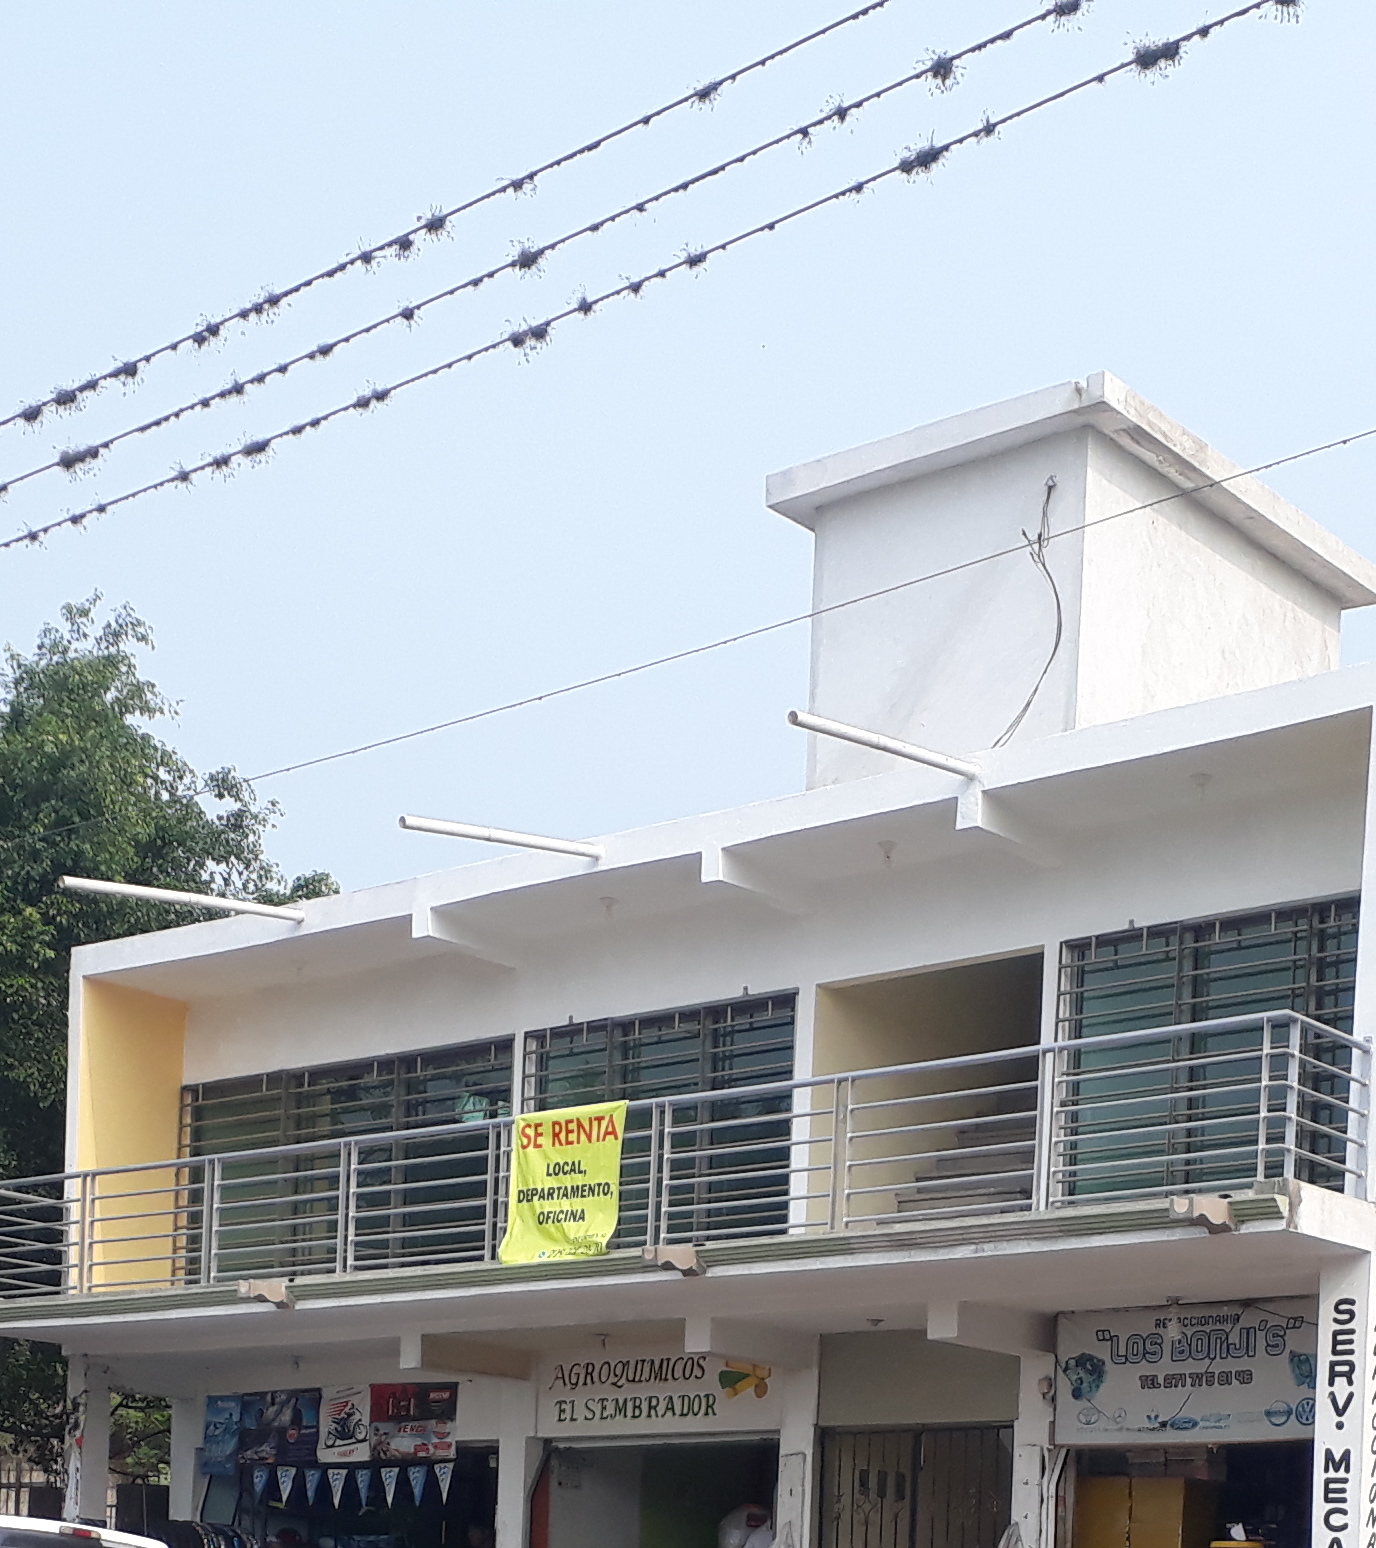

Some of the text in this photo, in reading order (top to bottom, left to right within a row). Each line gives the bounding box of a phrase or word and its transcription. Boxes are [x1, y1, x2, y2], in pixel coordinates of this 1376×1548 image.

[520, 1113, 619, 1150] SE RENTA
[545, 1160, 587, 1177] LOCAL,
[517, 1181, 613, 1204] DEPARTAMENTO,
[537, 1208, 586, 1225] OFICINA
[1155, 1313, 1241, 1330] RECCIONARIA
[548, 1355, 707, 1391] AGROQUIMICOS
[1139, 1374, 1162, 1389] TEL
[554, 1393, 718, 1423] EL SEMBRADOR
